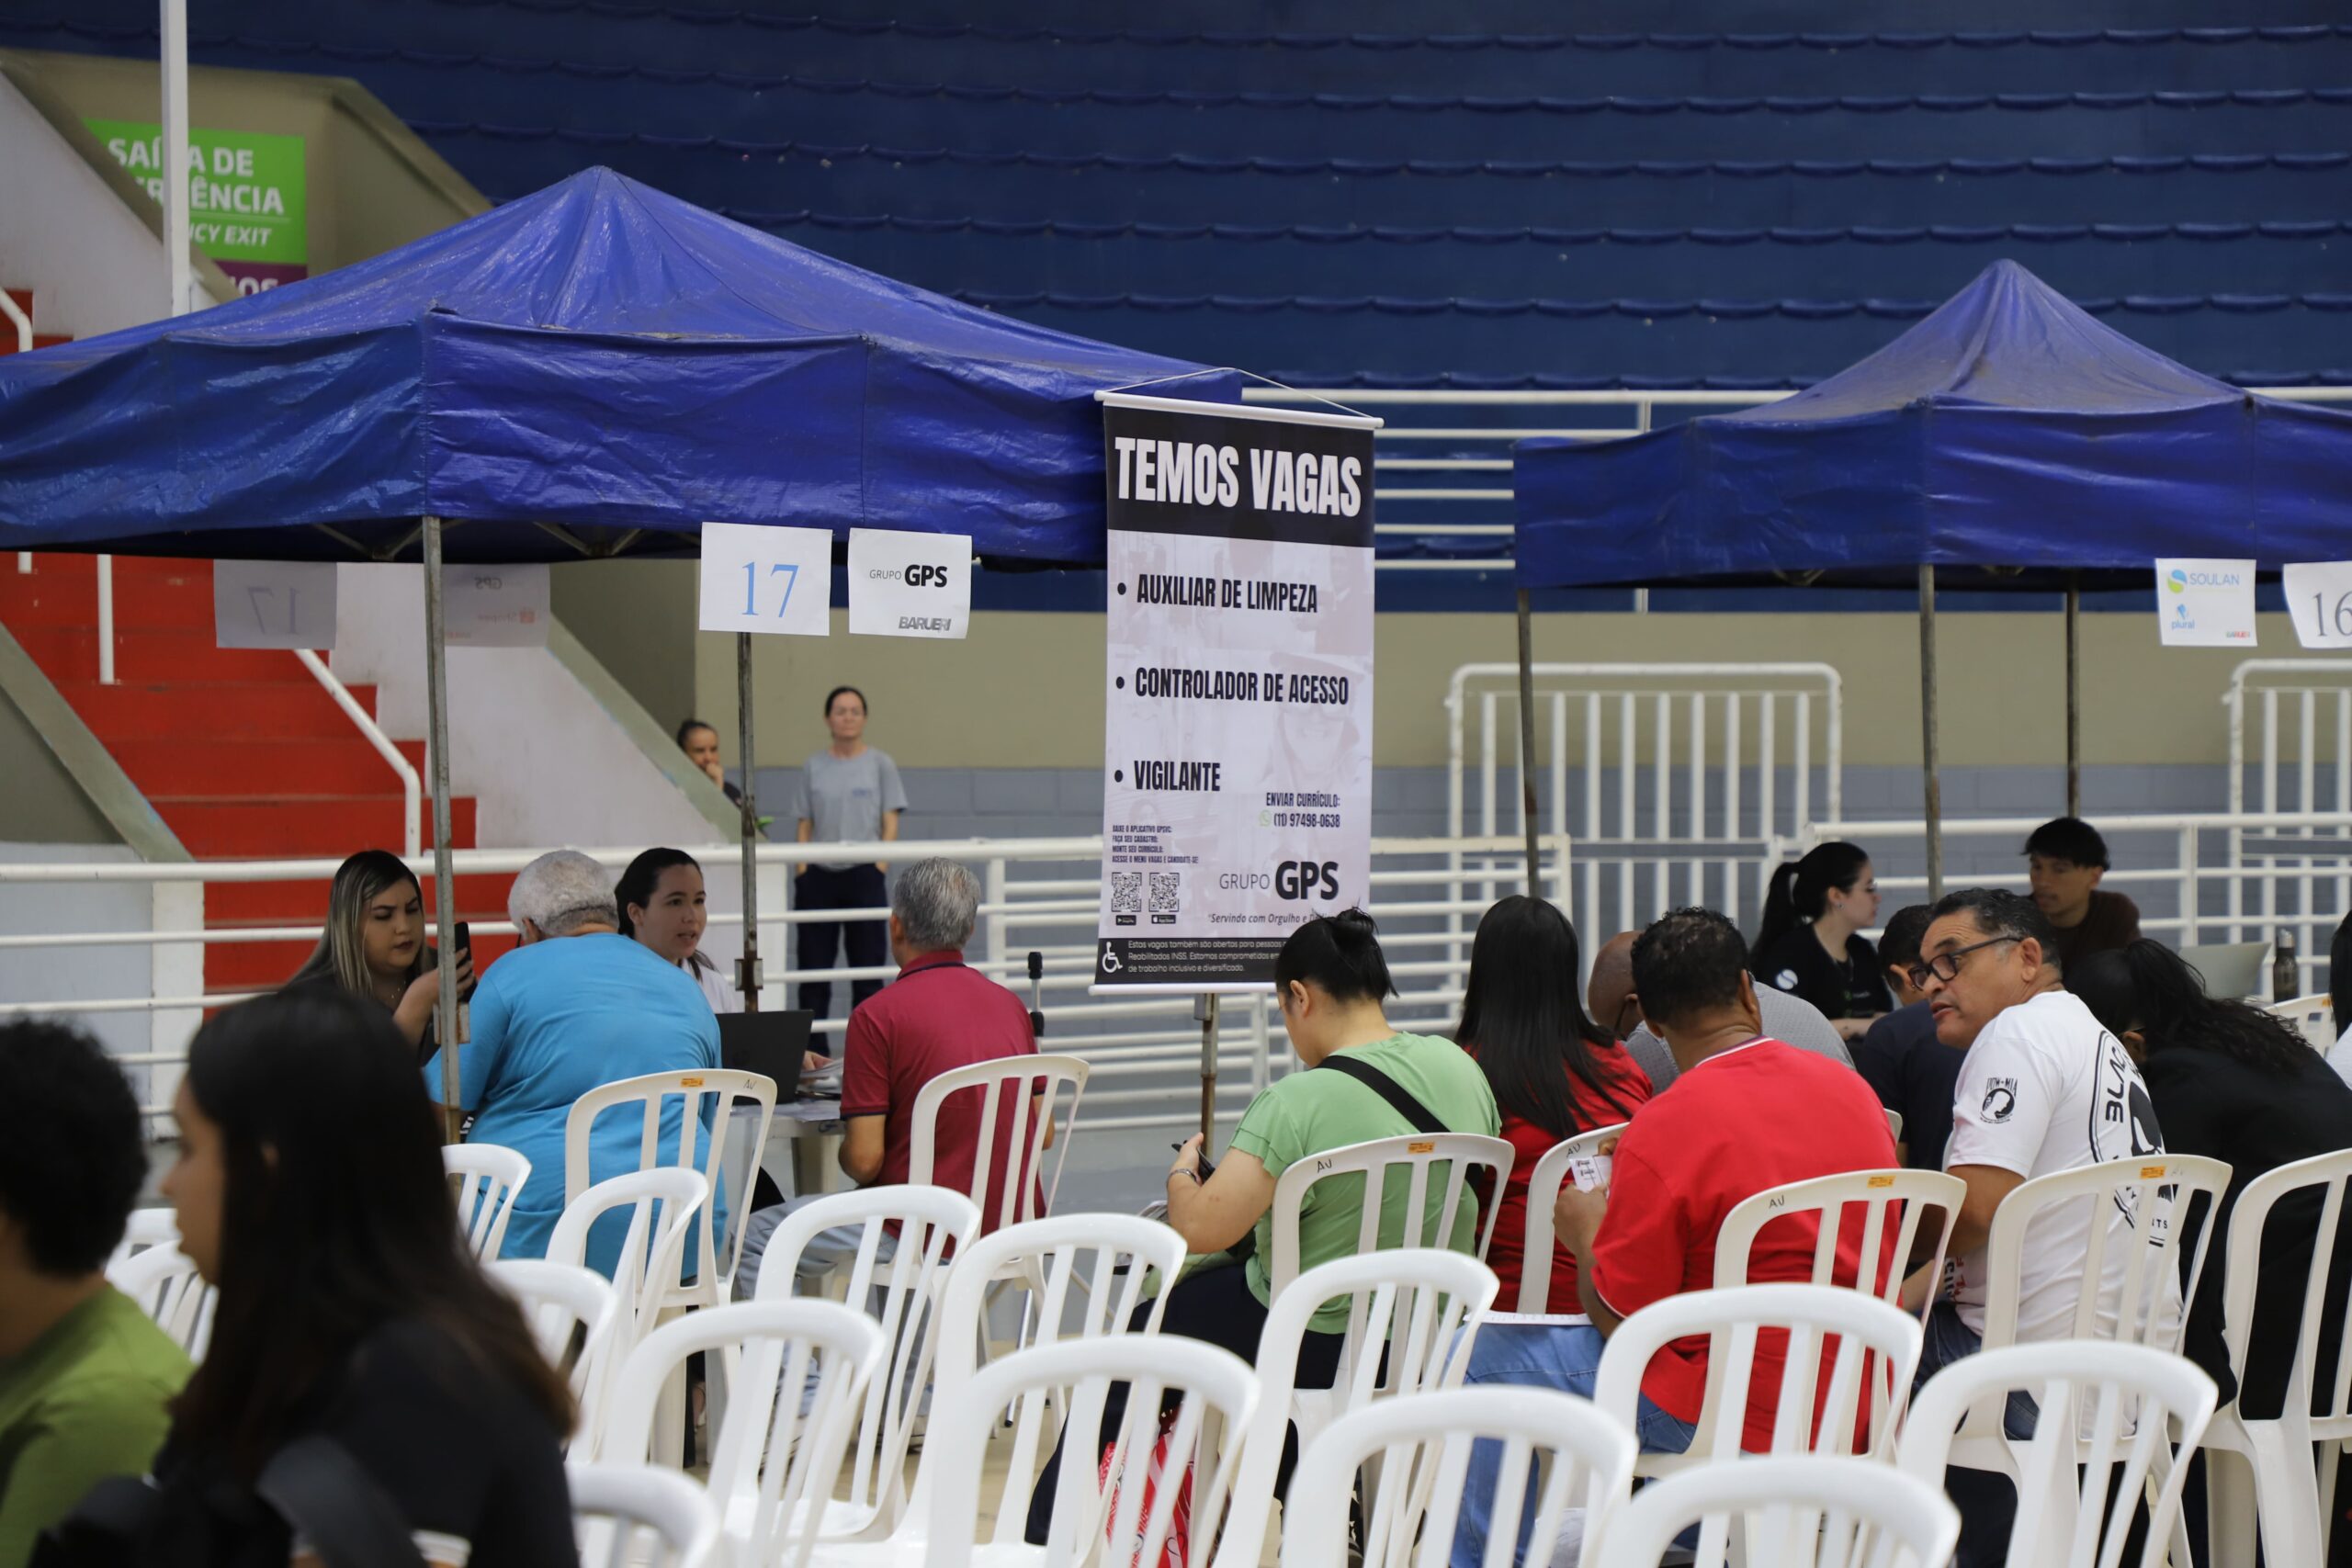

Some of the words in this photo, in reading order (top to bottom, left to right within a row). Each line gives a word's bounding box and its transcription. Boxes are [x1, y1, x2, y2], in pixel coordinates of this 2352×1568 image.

[107, 137, 206, 173] SAÍA
[213, 147, 254, 176] DE
[224, 225, 272, 246] EXIT
[1114, 436, 1239, 507] TEMOS
[1250, 448, 1362, 517] VAGAS
[869, 569, 902, 581] GRUPO
[904, 564, 948, 588] GPS
[2189, 572, 2240, 586] SOULAN
[741, 561, 799, 618] 17
[1136, 574, 1216, 606] AUXILIAR
[1222, 579, 1241, 608] DE
[1248, 581, 1317, 613] LIMPEZA
[899, 615, 951, 632] BARUERI
[2171, 619, 2195, 630] plural
[1136, 667, 1258, 701] CONTROLADOR
[1263, 673, 1283, 702] DE
[1288, 674, 1349, 705] ACESSO
[1134, 760, 1221, 791] VIGILANTE
[1266, 793, 1294, 807] ENVIAR
[1296, 790, 1340, 807] CURRÍCULO:
[1290, 813, 1340, 828] 97498-0638
[1219, 874, 1270, 889] GRUPO
[1275, 861, 1339, 900] GPS
[1268, 913, 1300, 926] Orgulho
[1148, 942, 1168, 950] vagas
[1128, 952, 1170, 960] Reabilitados
[1128, 964, 1137, 973] de
[1138, 964, 1167, 973] trabalho
[1169, 964, 1196, 972] inclusivo
